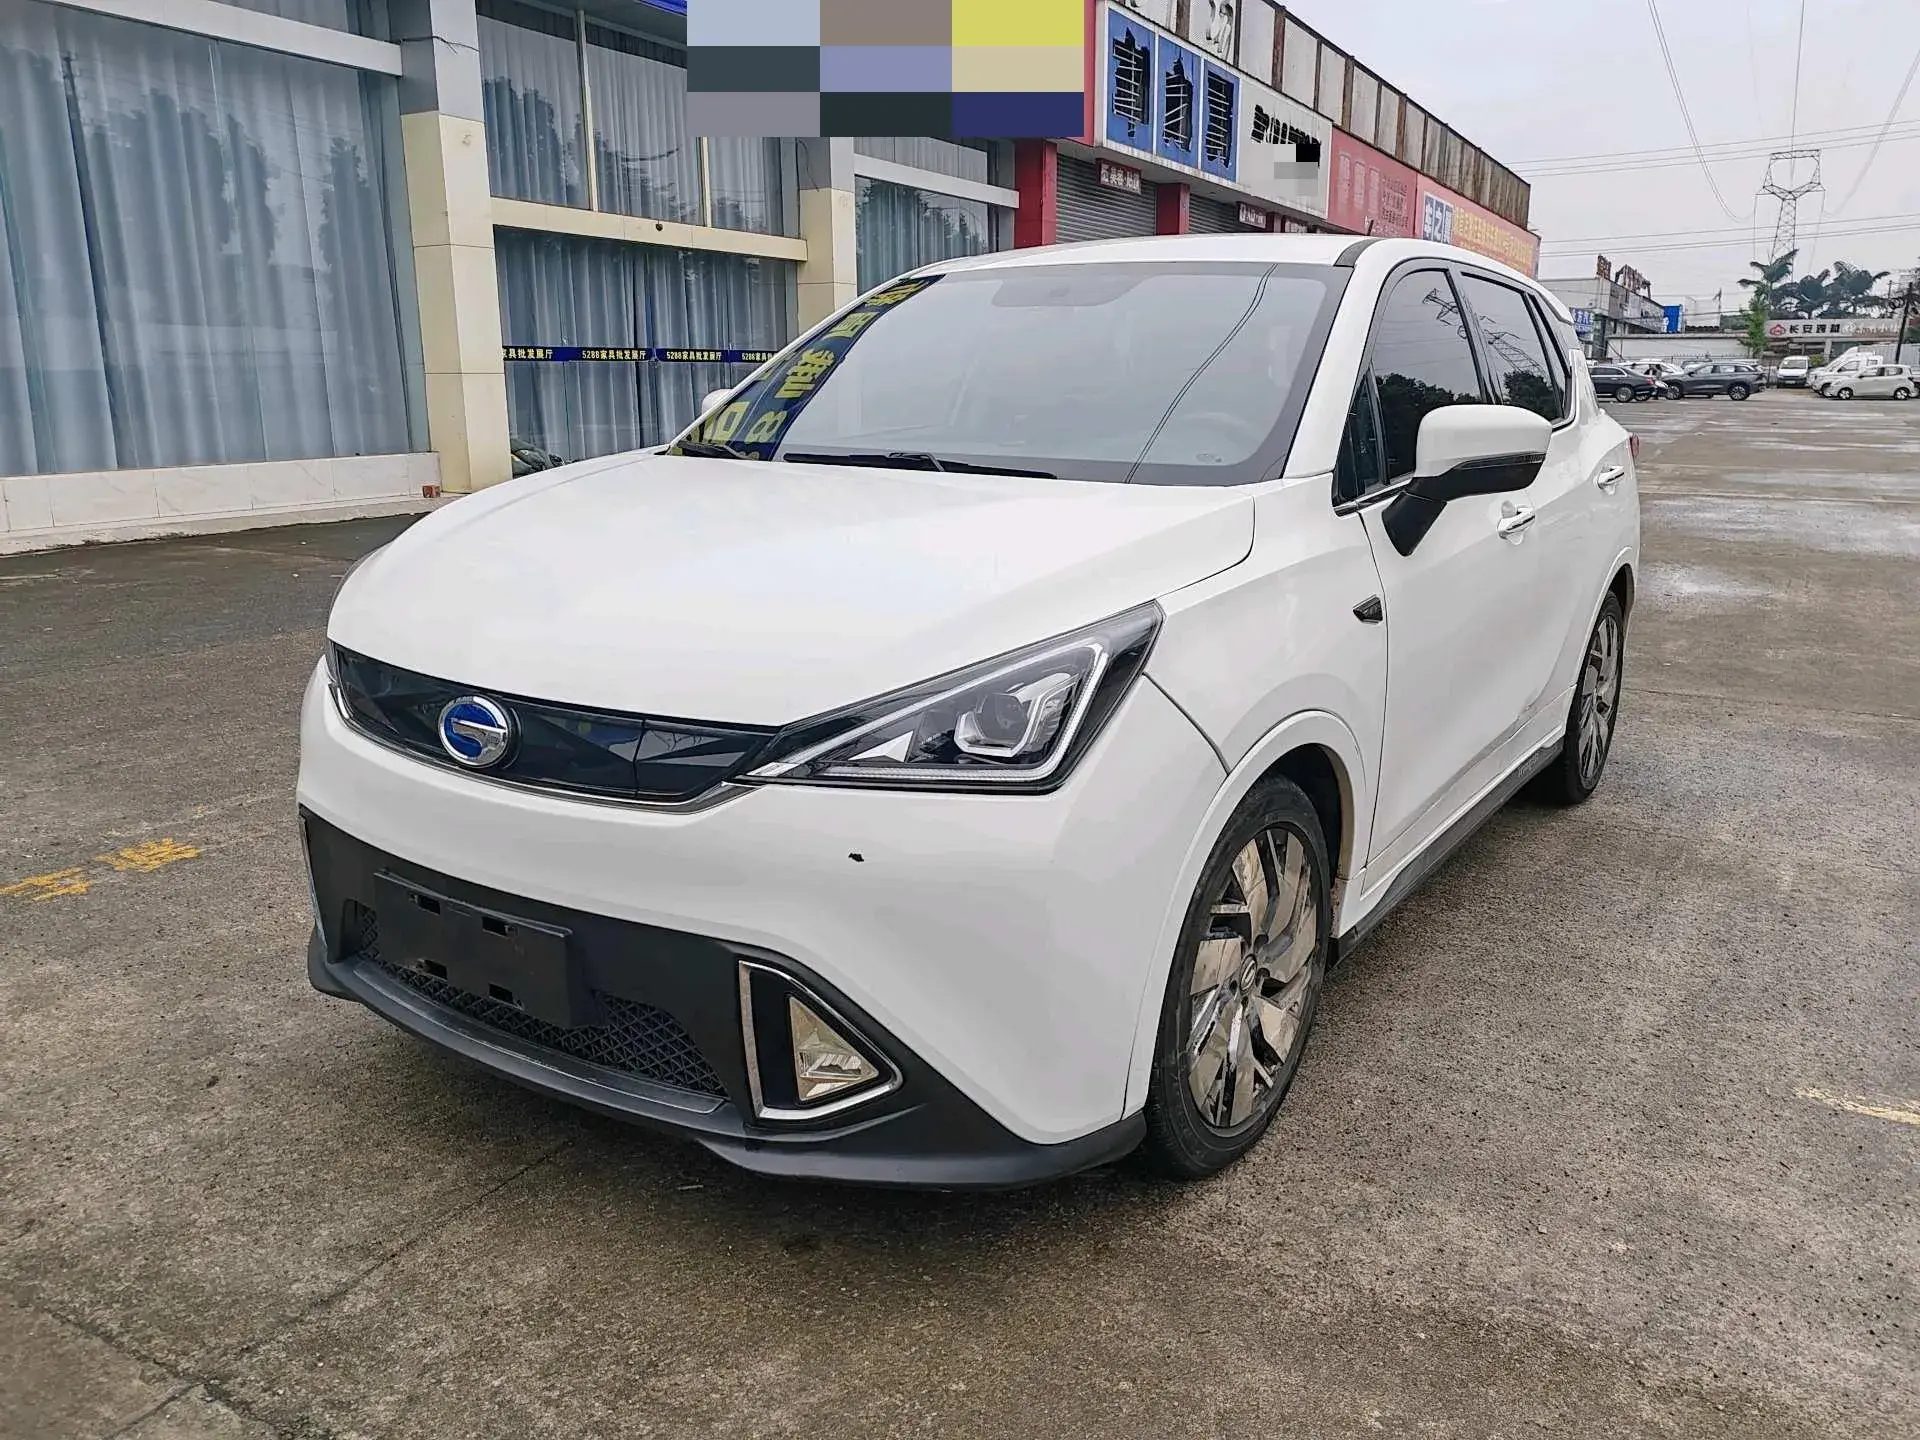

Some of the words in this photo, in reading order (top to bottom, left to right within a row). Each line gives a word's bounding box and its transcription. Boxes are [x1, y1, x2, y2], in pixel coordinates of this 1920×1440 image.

[582, 350, 646, 360] 5288家具批发展厅
